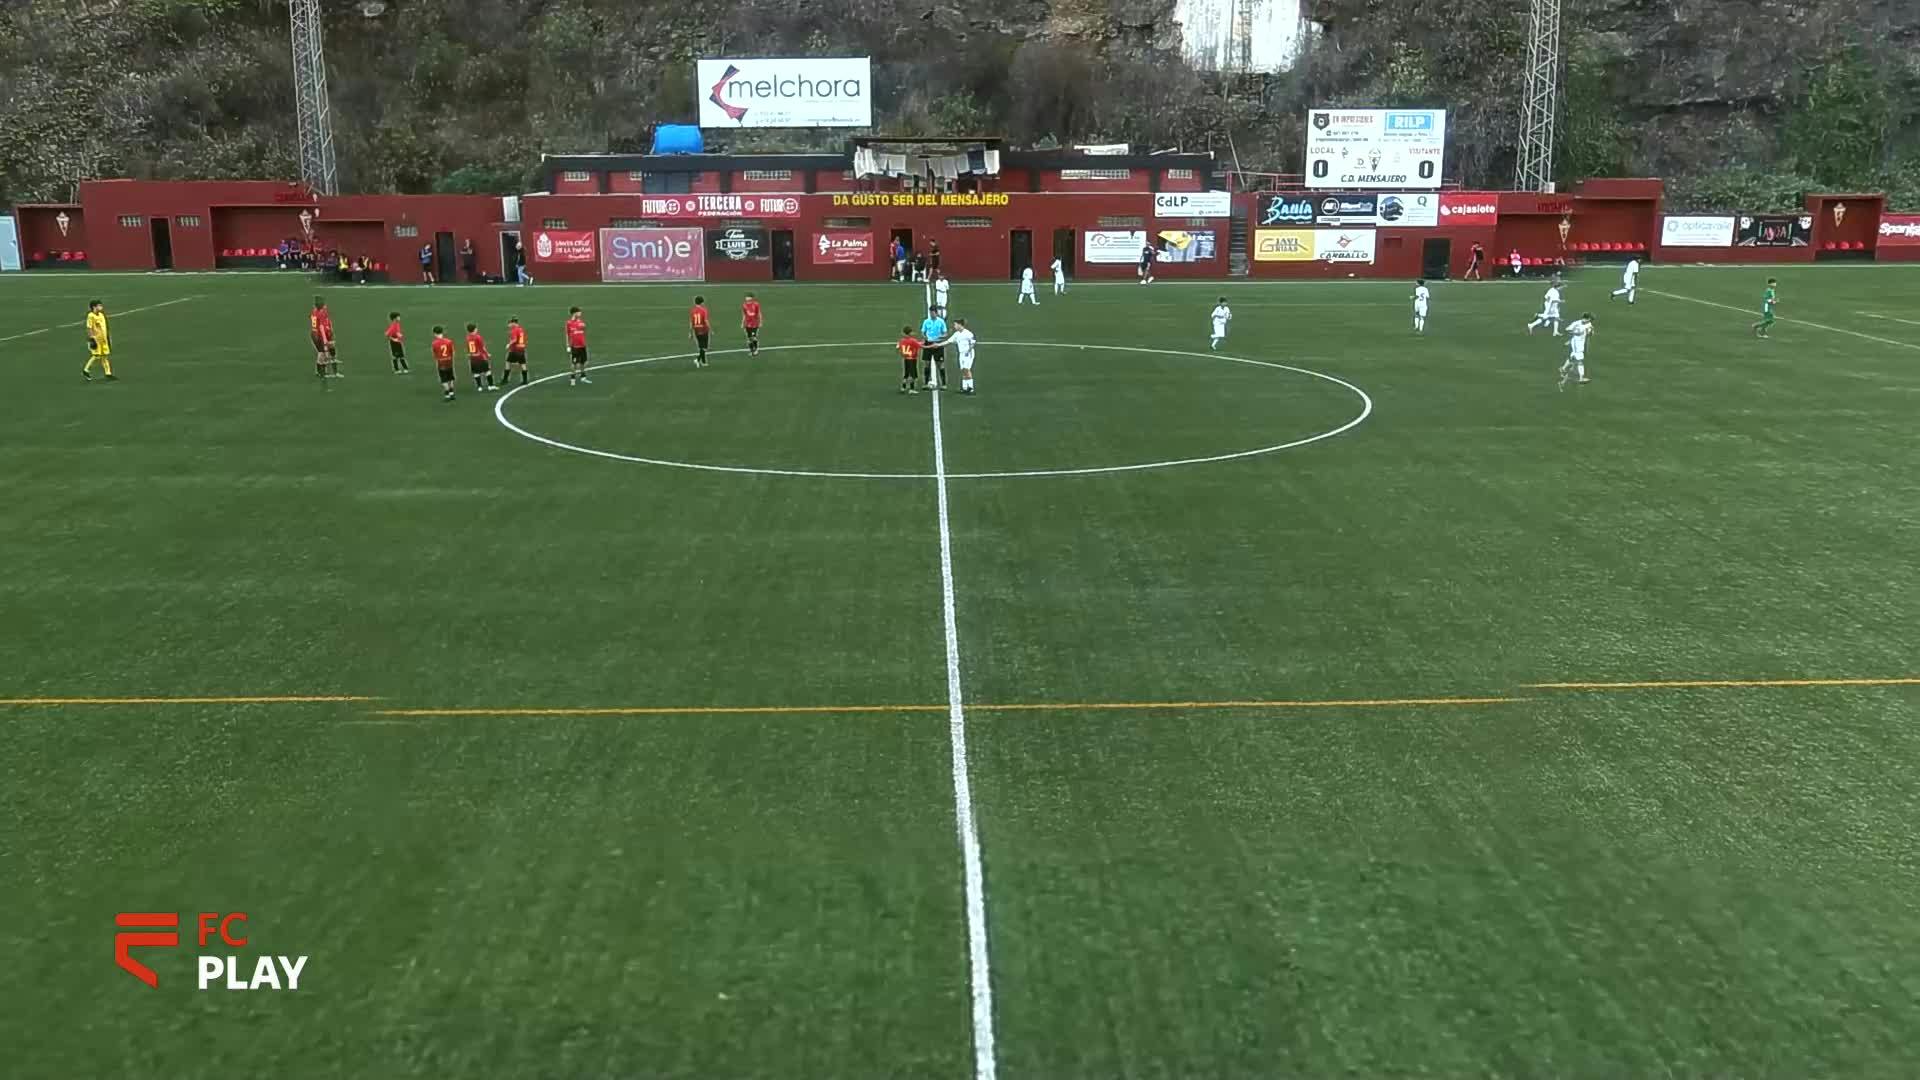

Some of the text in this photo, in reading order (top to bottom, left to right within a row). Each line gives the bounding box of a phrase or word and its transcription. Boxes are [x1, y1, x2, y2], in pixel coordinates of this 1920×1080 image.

[729, 74, 860, 98] melchora
[1313, 159, 1329, 178] 0
[1418, 160, 1434, 179] 0
[1357, 175, 1407, 183] MENSAJERO
[698, 196, 742, 211] TERCERA
[833, 193, 1009, 206] DA GUSTO SER DEL MENSAJERO
[843, 239, 868, 247] Palma
[441, 344, 448, 357] 2
